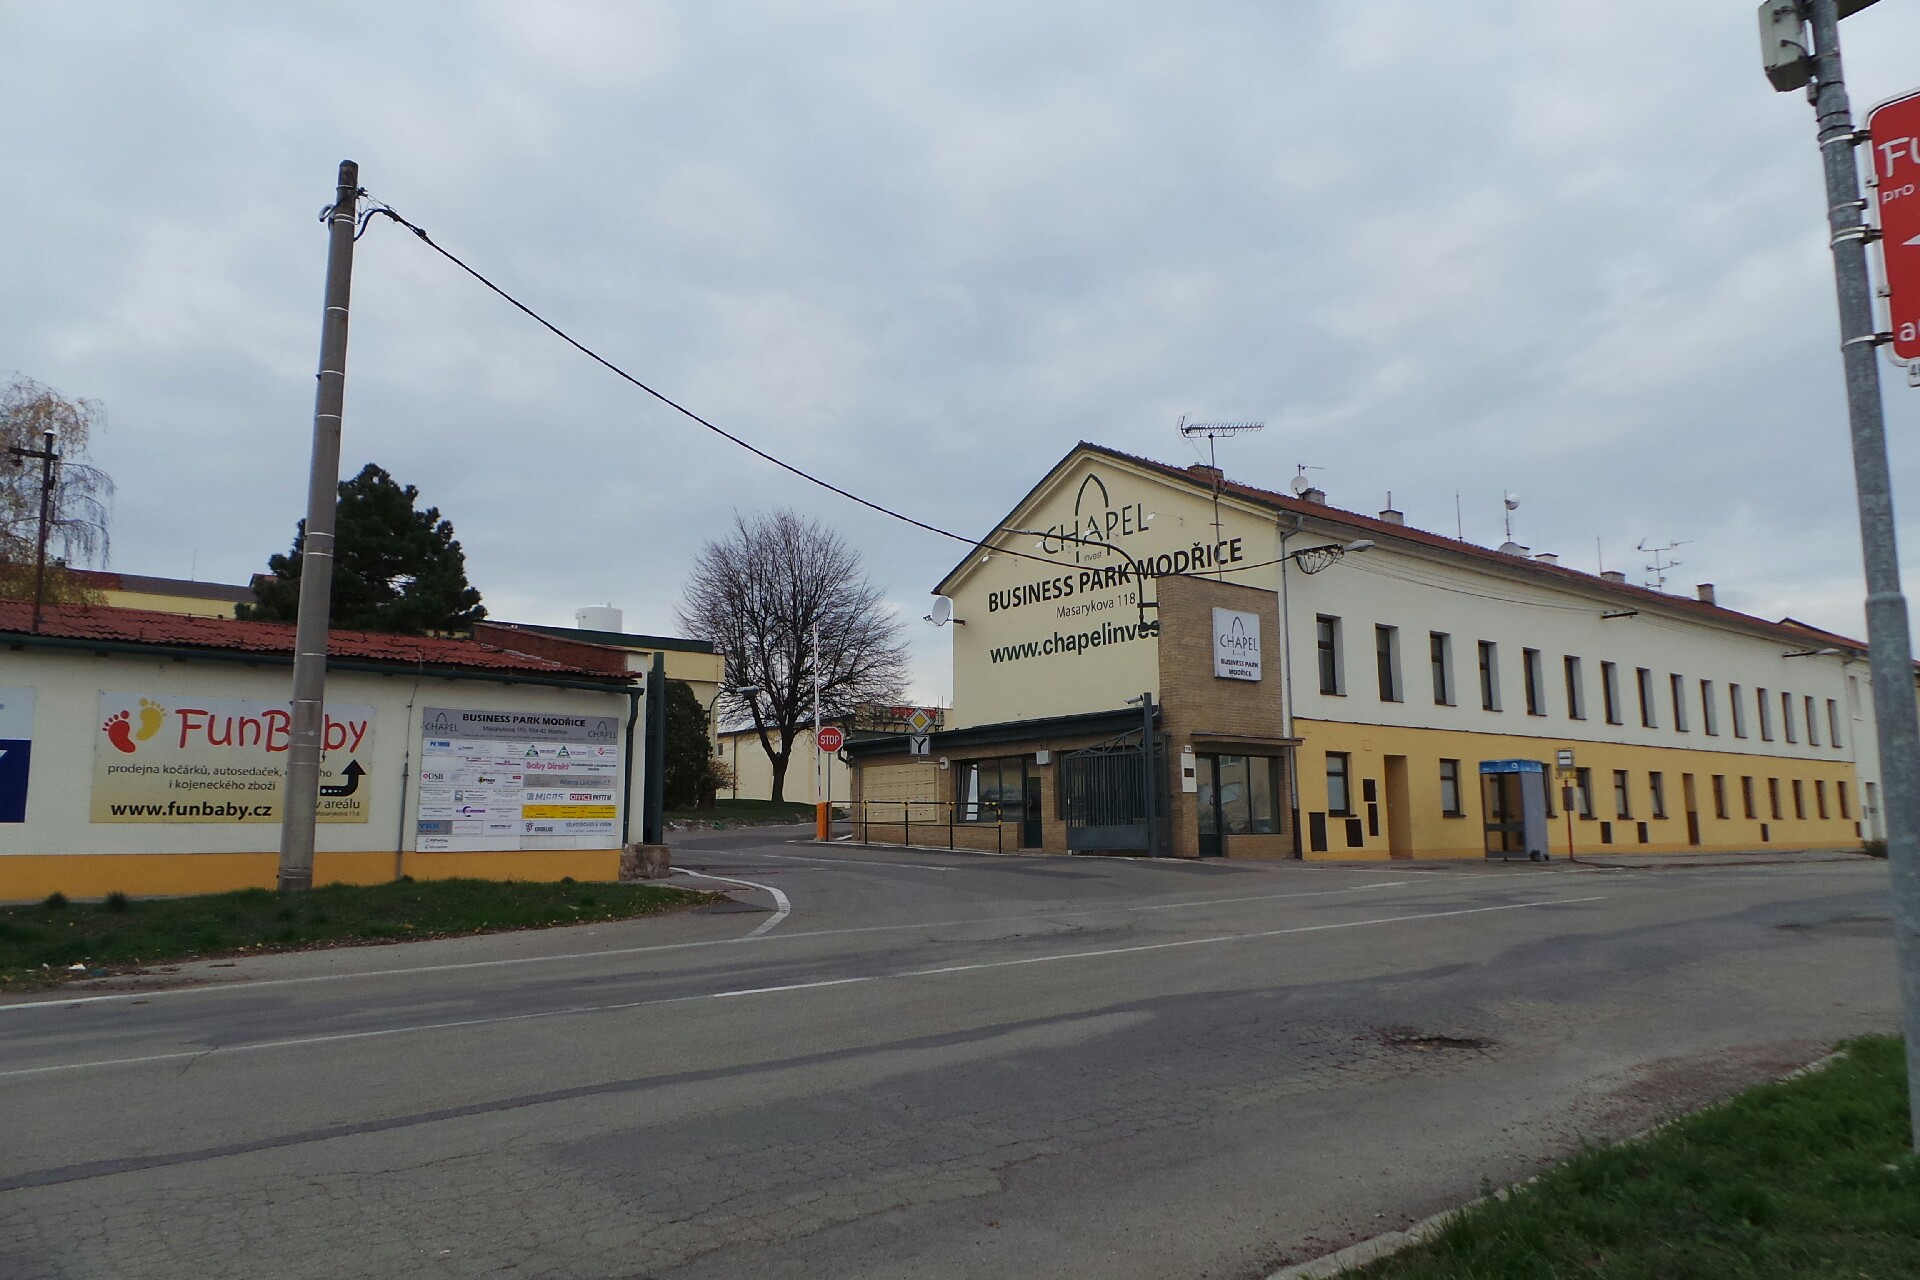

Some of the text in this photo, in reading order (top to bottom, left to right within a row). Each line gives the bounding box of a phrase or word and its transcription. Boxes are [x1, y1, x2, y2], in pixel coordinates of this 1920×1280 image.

[1882, 184, 1914, 204] pro
[1900, 320, 1920, 341] a
[1043, 500, 1149, 563] CHAPEL
[988, 537, 1243, 612] BUSINESS PARK MODŘICE
[1056, 592, 1136, 618] Masarykova 118
[1220, 632, 1258, 656] CHAPEL
[1221, 658, 1244, 667] BUSINESS
[462, 713, 586, 727] BUSINESS PARK MODŘICE
[175, 709, 367, 753] FunBby
[425, 722, 458, 735] CHAPEL
[588, 729, 616, 741] CHAPEL
[820, 735, 840, 745] STOP
[108, 764, 160, 776] prodejna
[163, 764, 210, 776] kočárků,
[213, 766, 282, 777] autosedaček,
[526, 762, 545, 771] Baby
[169, 780, 276, 791] i kojeneckého zboží
[111, 801, 272, 820] www.funbaby.cz
[324, 798, 360, 809] areálu
